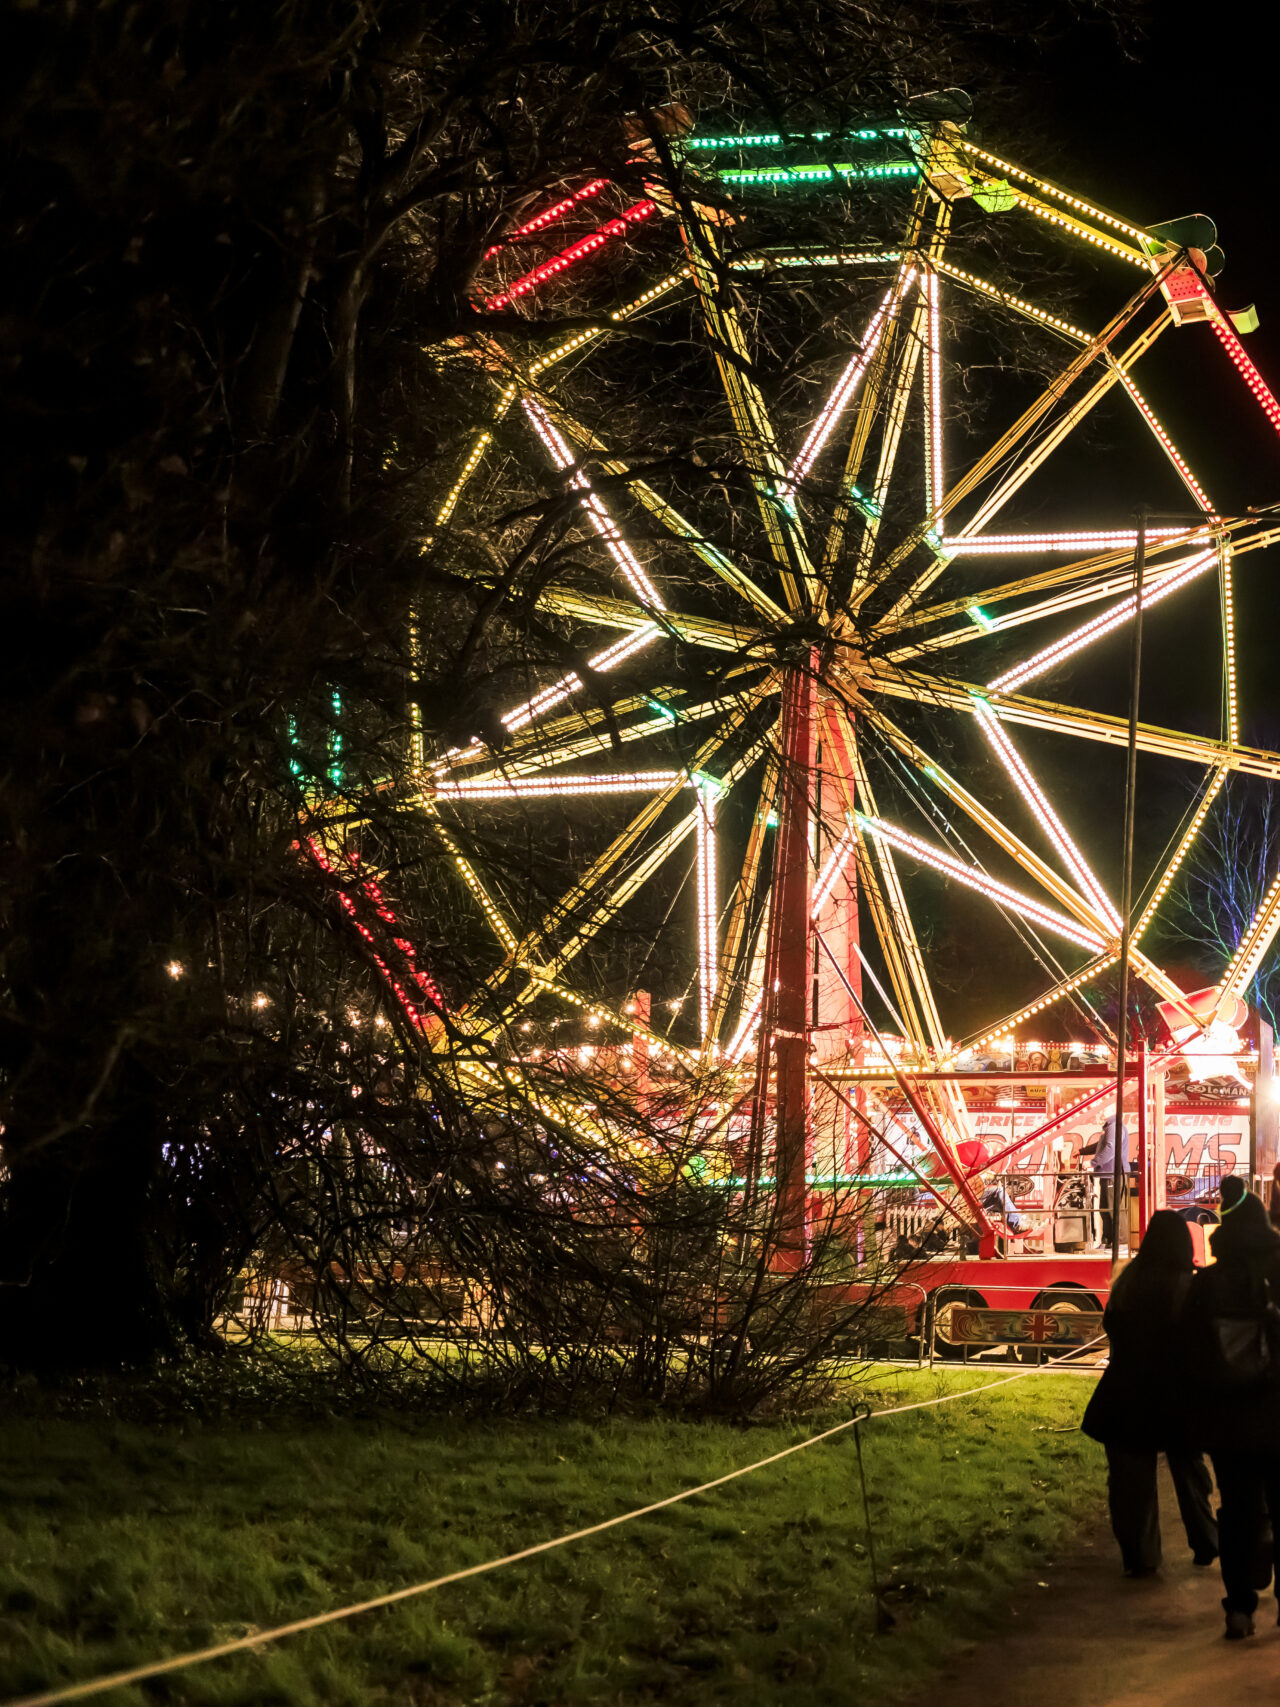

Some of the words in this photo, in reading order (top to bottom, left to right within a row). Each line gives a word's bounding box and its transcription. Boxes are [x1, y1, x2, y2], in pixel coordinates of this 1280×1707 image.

[1207, 1085, 1219, 1094] Le
[1222, 1086, 1250, 1096] MAN
[975, 1115, 1044, 1127] PRICE'
[1163, 1115, 1233, 1127] ACING
